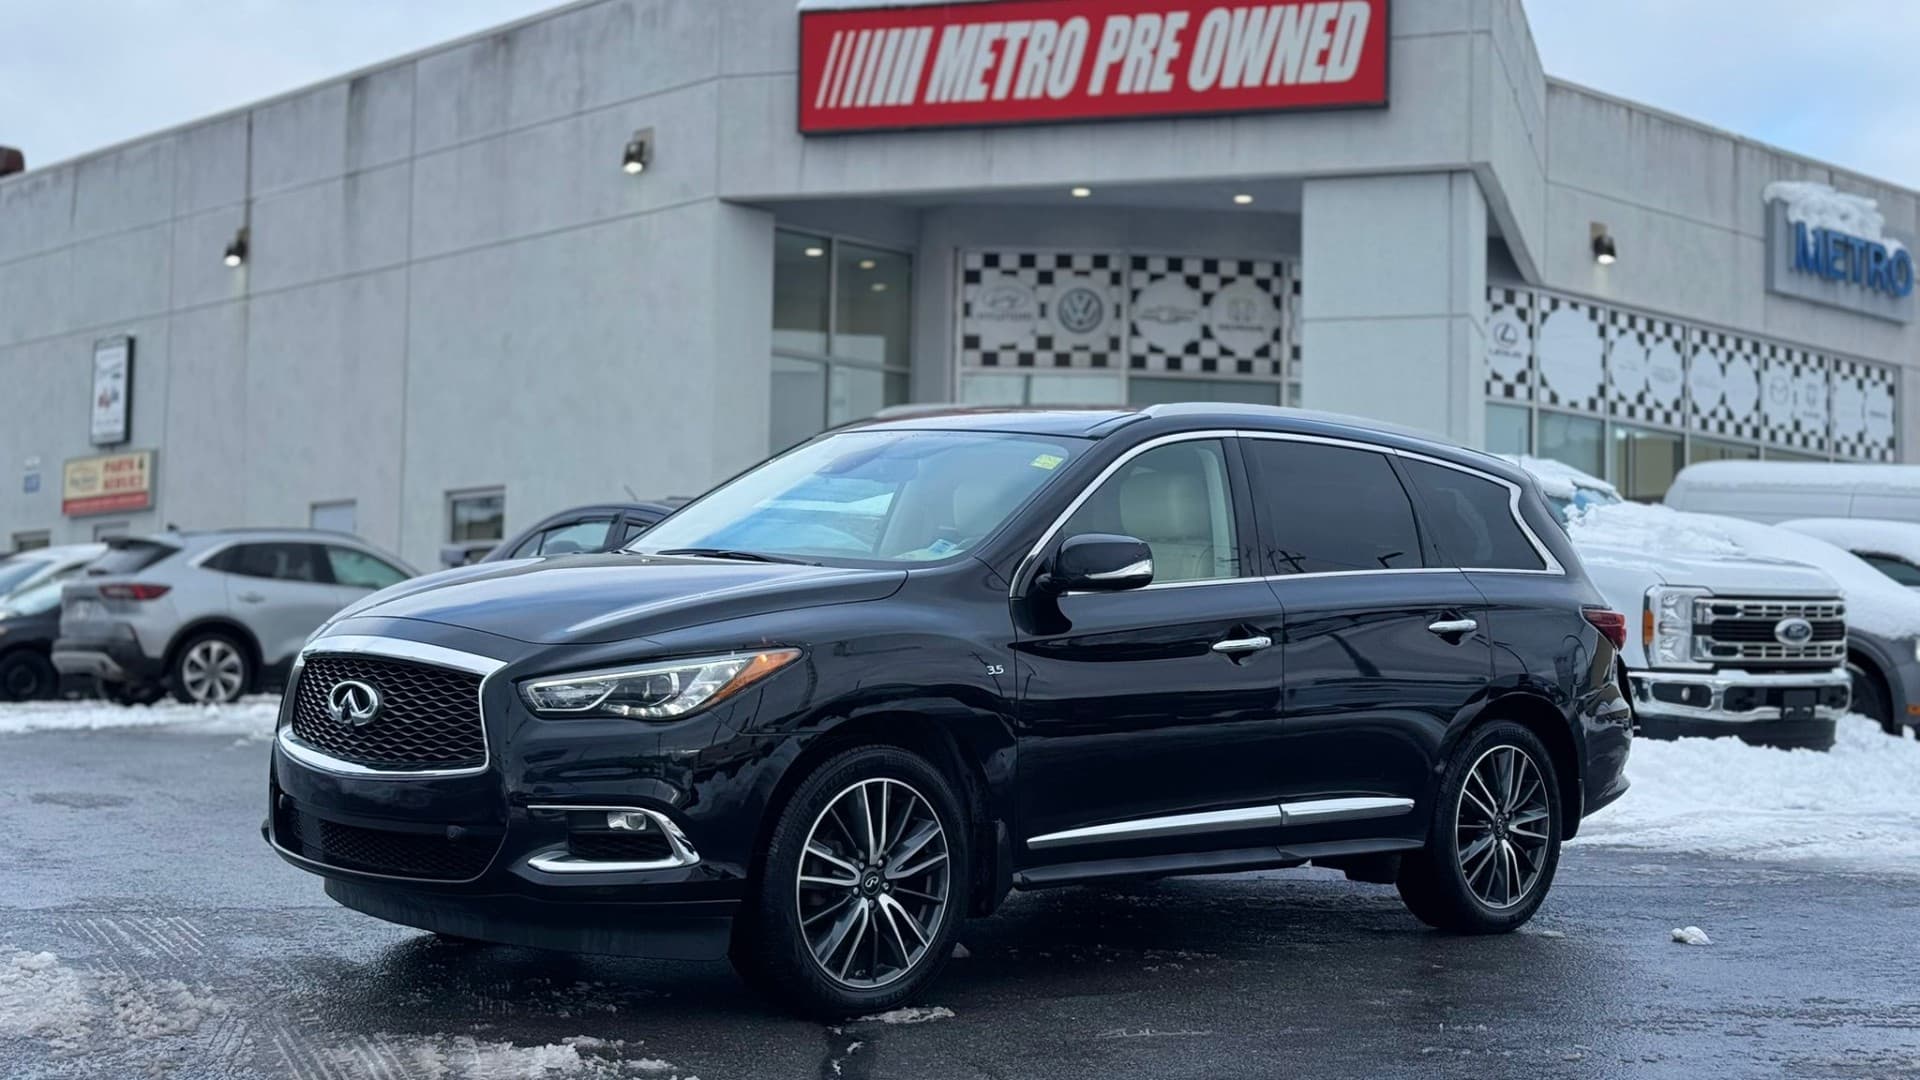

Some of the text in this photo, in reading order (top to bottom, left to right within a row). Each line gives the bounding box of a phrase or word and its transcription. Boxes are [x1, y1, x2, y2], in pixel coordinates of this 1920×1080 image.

[925, 1, 1371, 104] METRO PRE OWNED
[1795, 219, 1914, 298] METRO
